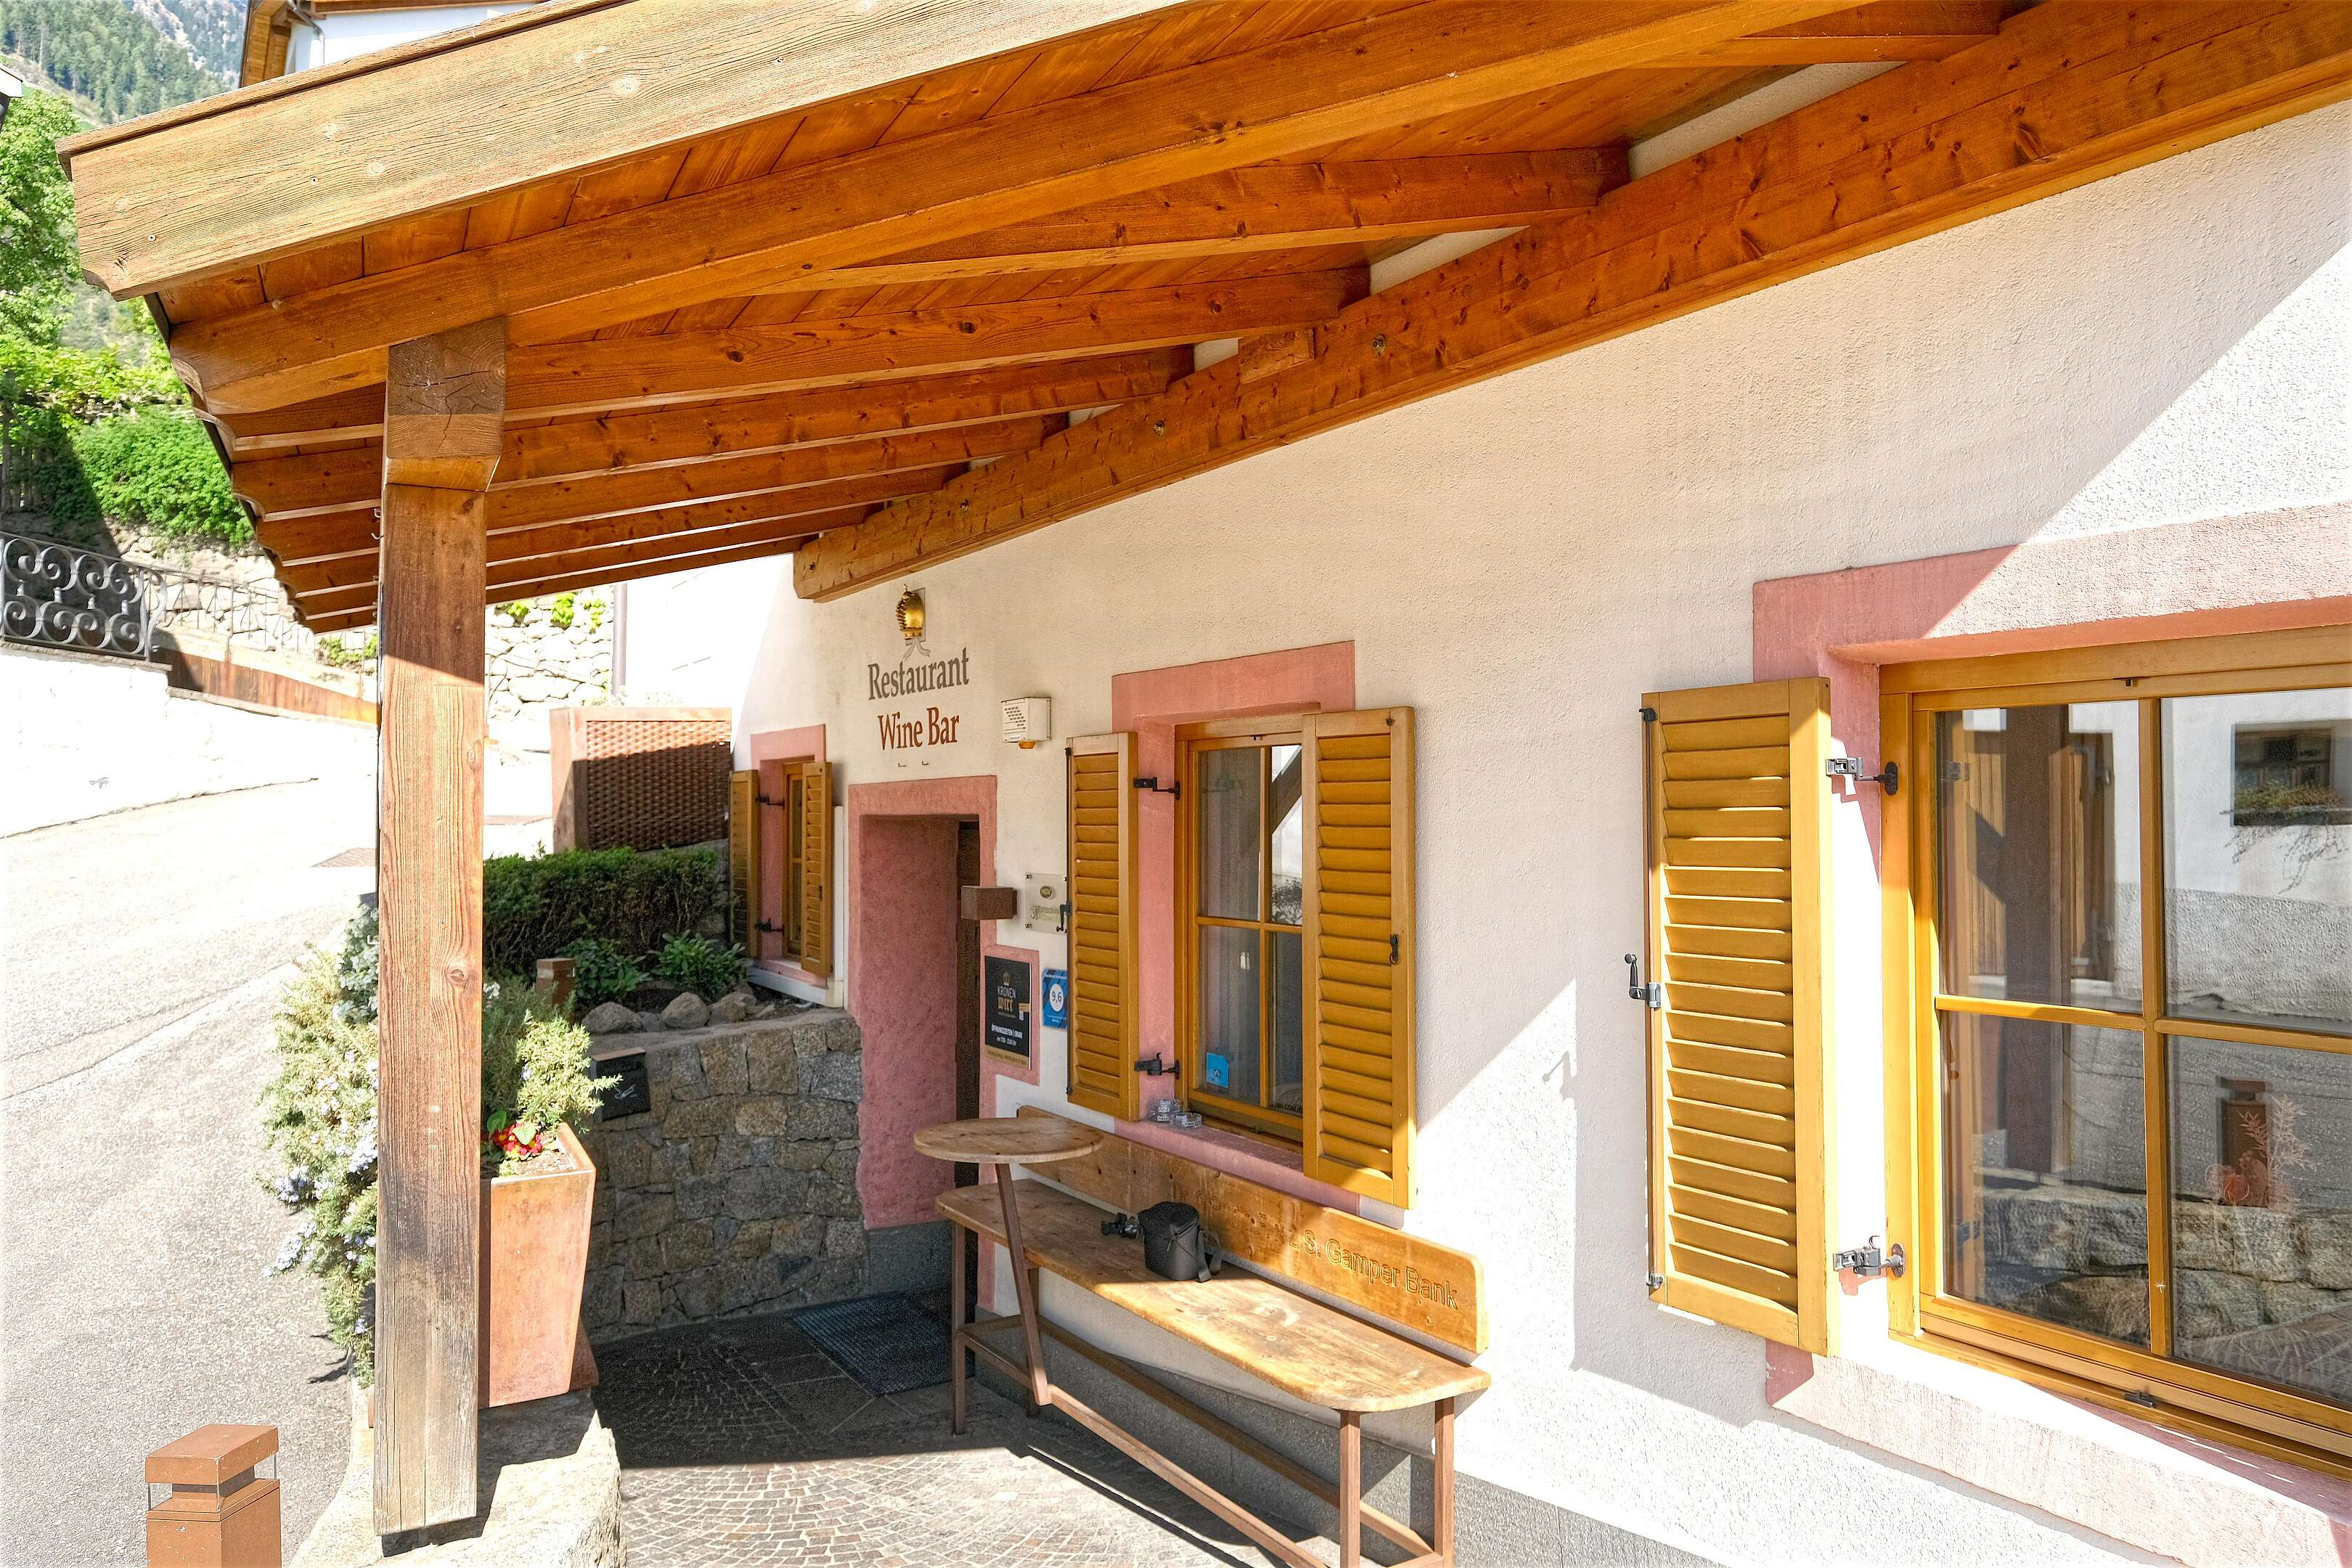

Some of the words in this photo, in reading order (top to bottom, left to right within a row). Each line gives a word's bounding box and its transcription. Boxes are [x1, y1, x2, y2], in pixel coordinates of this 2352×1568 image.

[867, 646, 970, 700] Restaurant
[878, 711, 923, 751] Wine
[927, 706, 960, 745] Bar
[997, 986, 1016, 999] KRONEN
[1052, 991, 1062, 1003] 9,6
[1303, 1230, 1321, 1258] S.
[1326, 1238, 1400, 1287] Gamper
[1405, 1265, 1458, 1311] Bank
